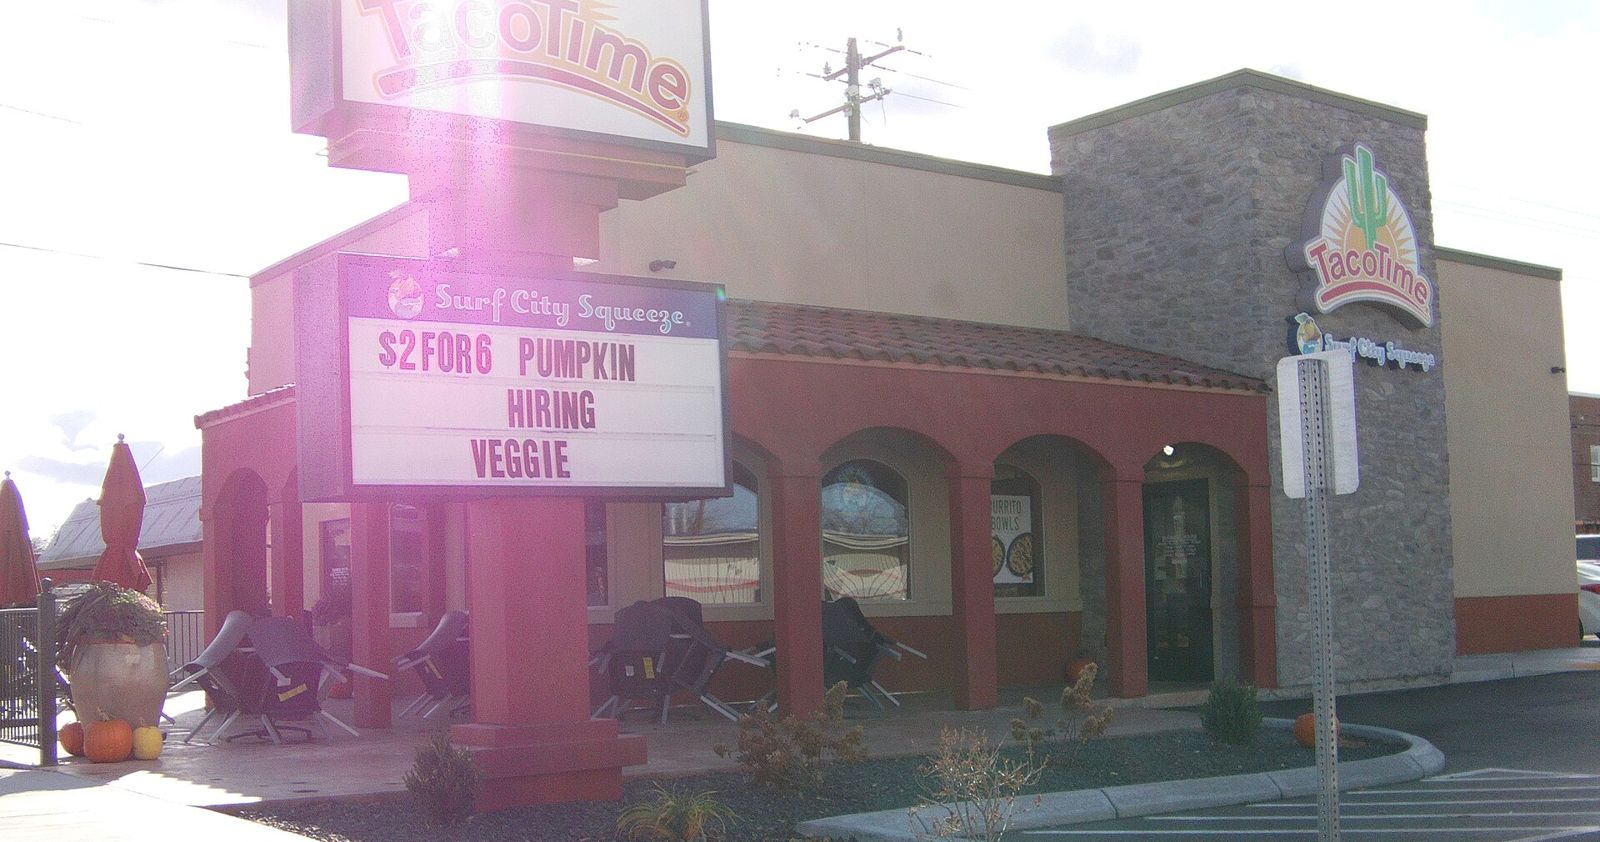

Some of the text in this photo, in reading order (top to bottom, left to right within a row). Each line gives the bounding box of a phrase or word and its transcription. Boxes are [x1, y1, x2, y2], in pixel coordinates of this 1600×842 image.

[357, 0, 687, 110] TacoTime
[1309, 241, 1429, 305] TacoTime
[435, 284, 684, 334] Surf City Squeeze
[519, 337, 636, 382] PUMPKIN
[507, 388, 596, 430] HIRING
[470, 438, 571, 480] VEGGIE
[991, 499, 1023, 515] URRITO
